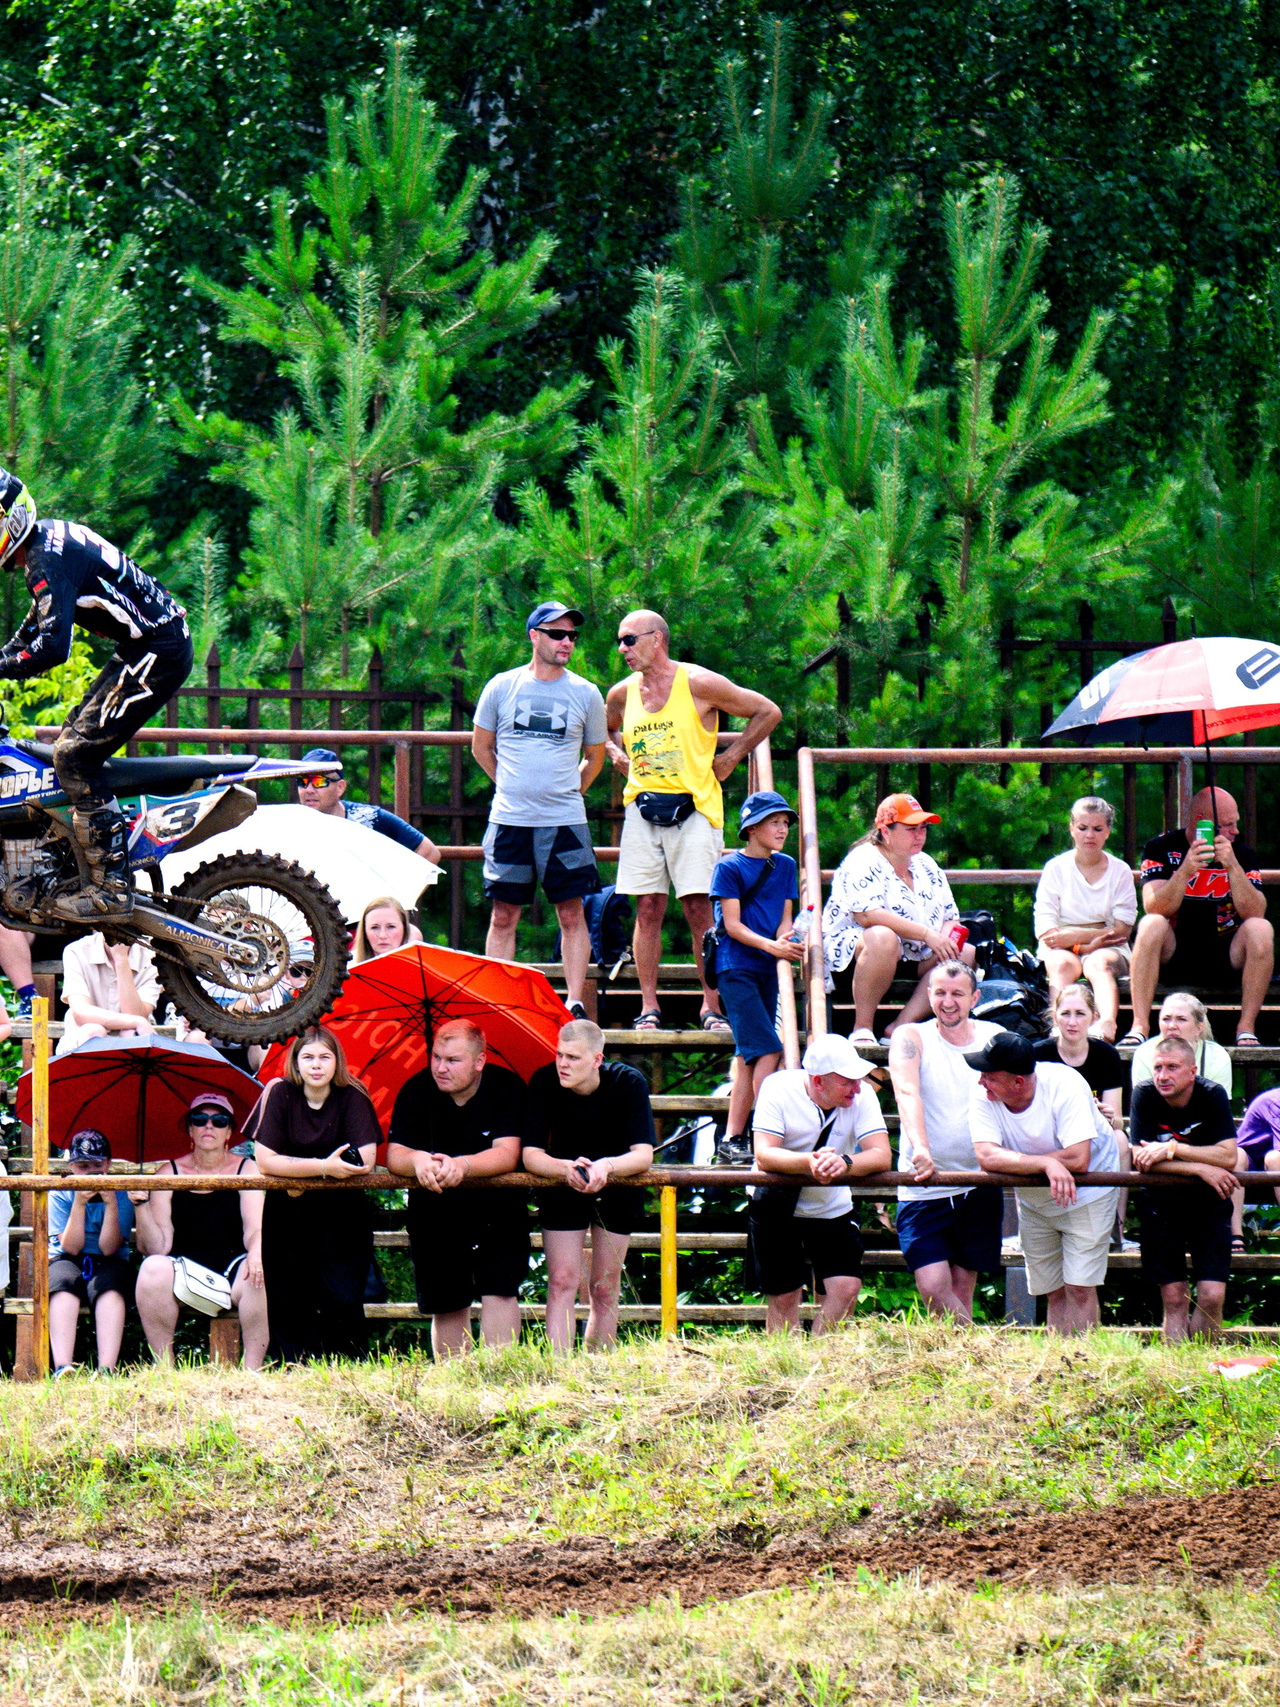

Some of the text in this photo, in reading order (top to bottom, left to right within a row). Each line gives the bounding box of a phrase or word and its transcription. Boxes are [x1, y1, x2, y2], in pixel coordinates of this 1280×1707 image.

[157, 801, 201, 839] 3
[129, 855, 157, 868] MONICA
[161, 922, 227, 952] ALMONICA
